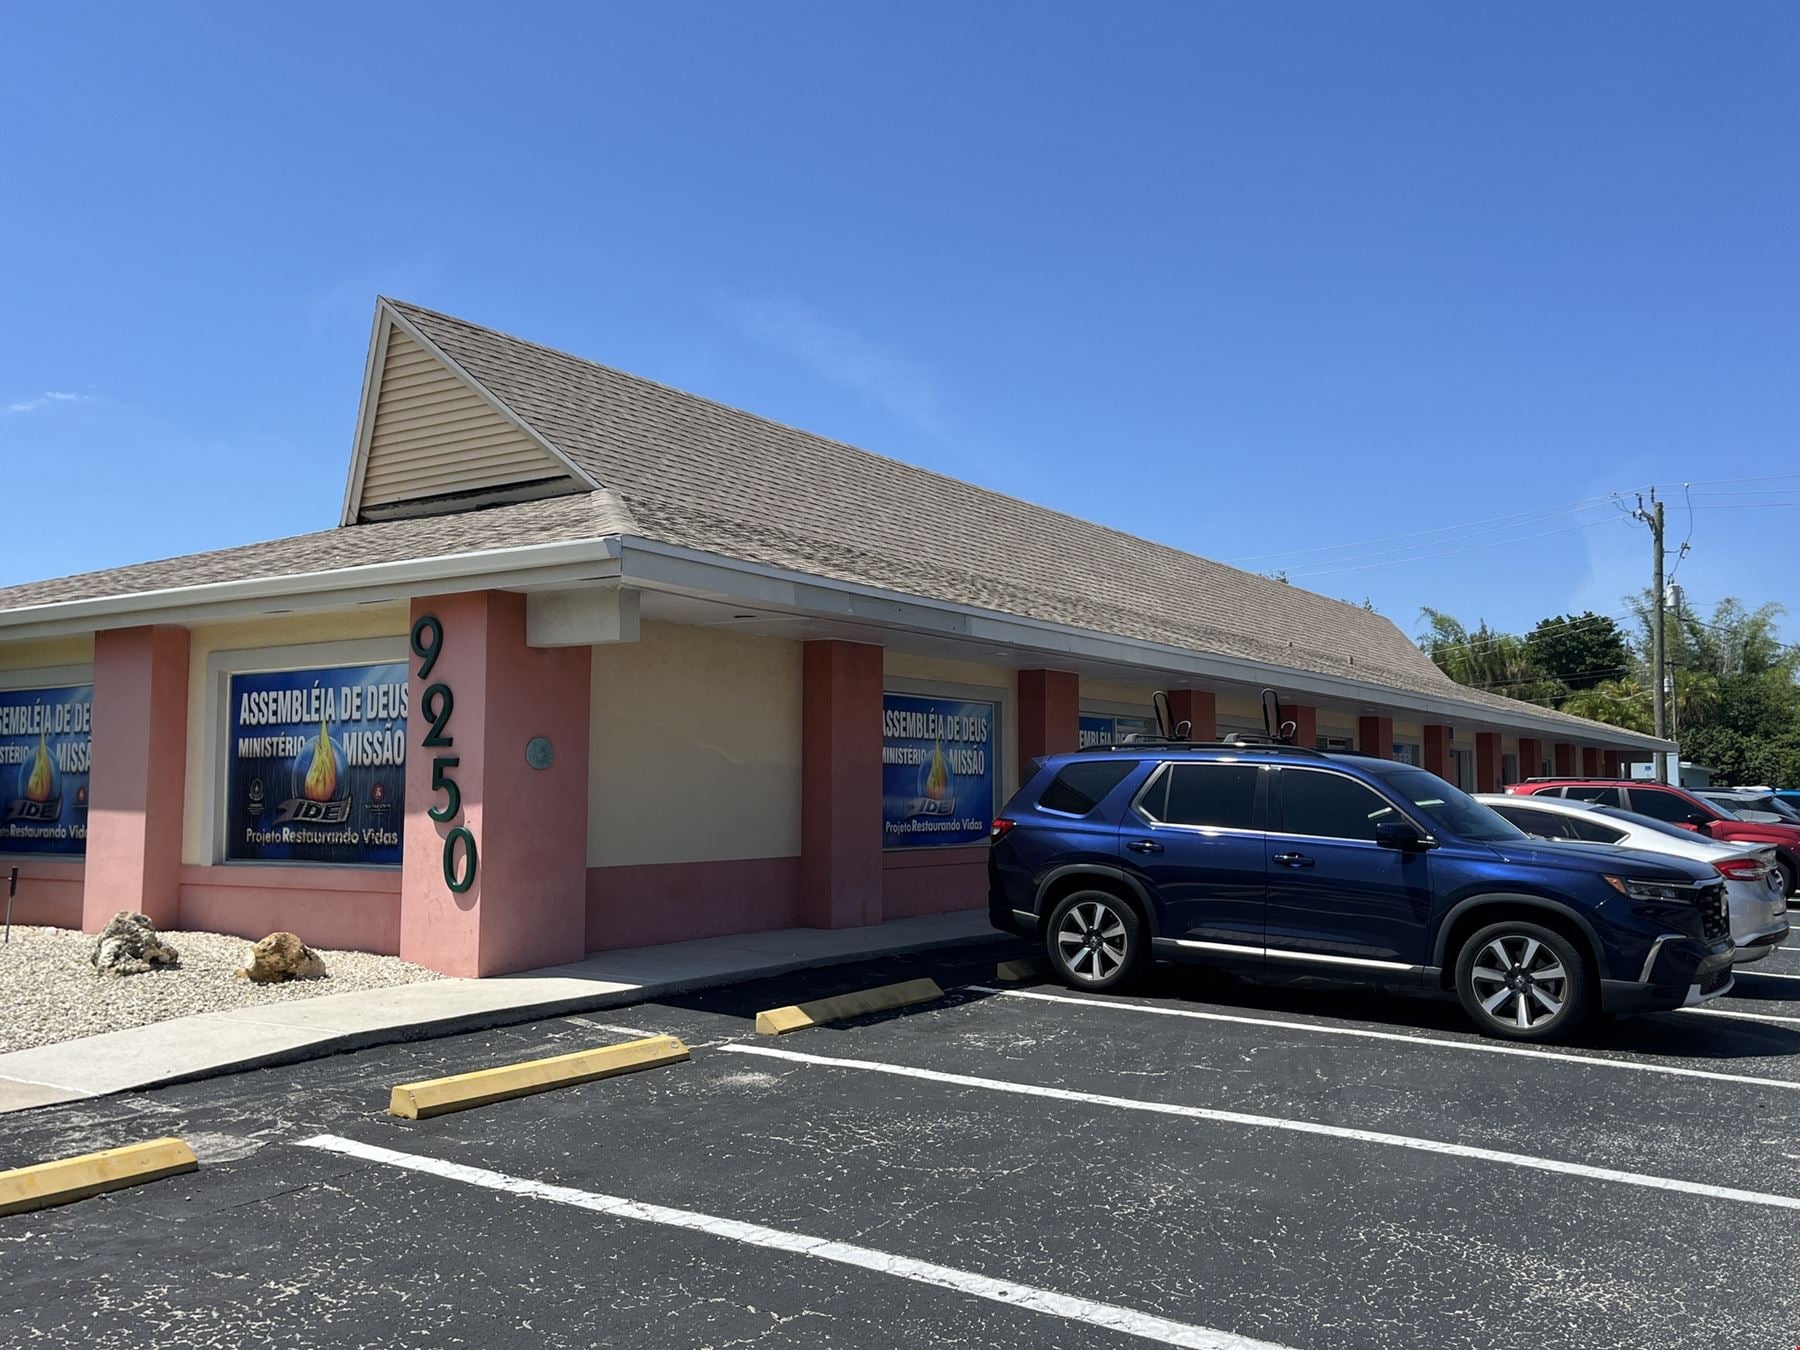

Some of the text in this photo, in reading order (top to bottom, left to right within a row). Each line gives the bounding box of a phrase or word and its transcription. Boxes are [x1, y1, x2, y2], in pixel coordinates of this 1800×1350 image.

[239, 680, 408, 726] ASSEMBLÉIA DE DEUS
[55, 704, 71, 733] DE
[947, 715, 960, 741] DE
[962, 717, 987, 742] DEUS
[238, 721, 404, 766] MINISTÉRIO MISSÃO
[411, 616, 477, 894] 9250
[950, 745, 985, 775] MISSÃO
[18, 801, 53, 818] IDE
[293, 801, 342, 820] IDE
[919, 801, 949, 814] IDE
[10, 824, 67, 838] Restaurando
[246, 827, 398, 846] Projeto Restaurando Vidas
[885, 818, 983, 836] Projeto Restaurando Vidas
